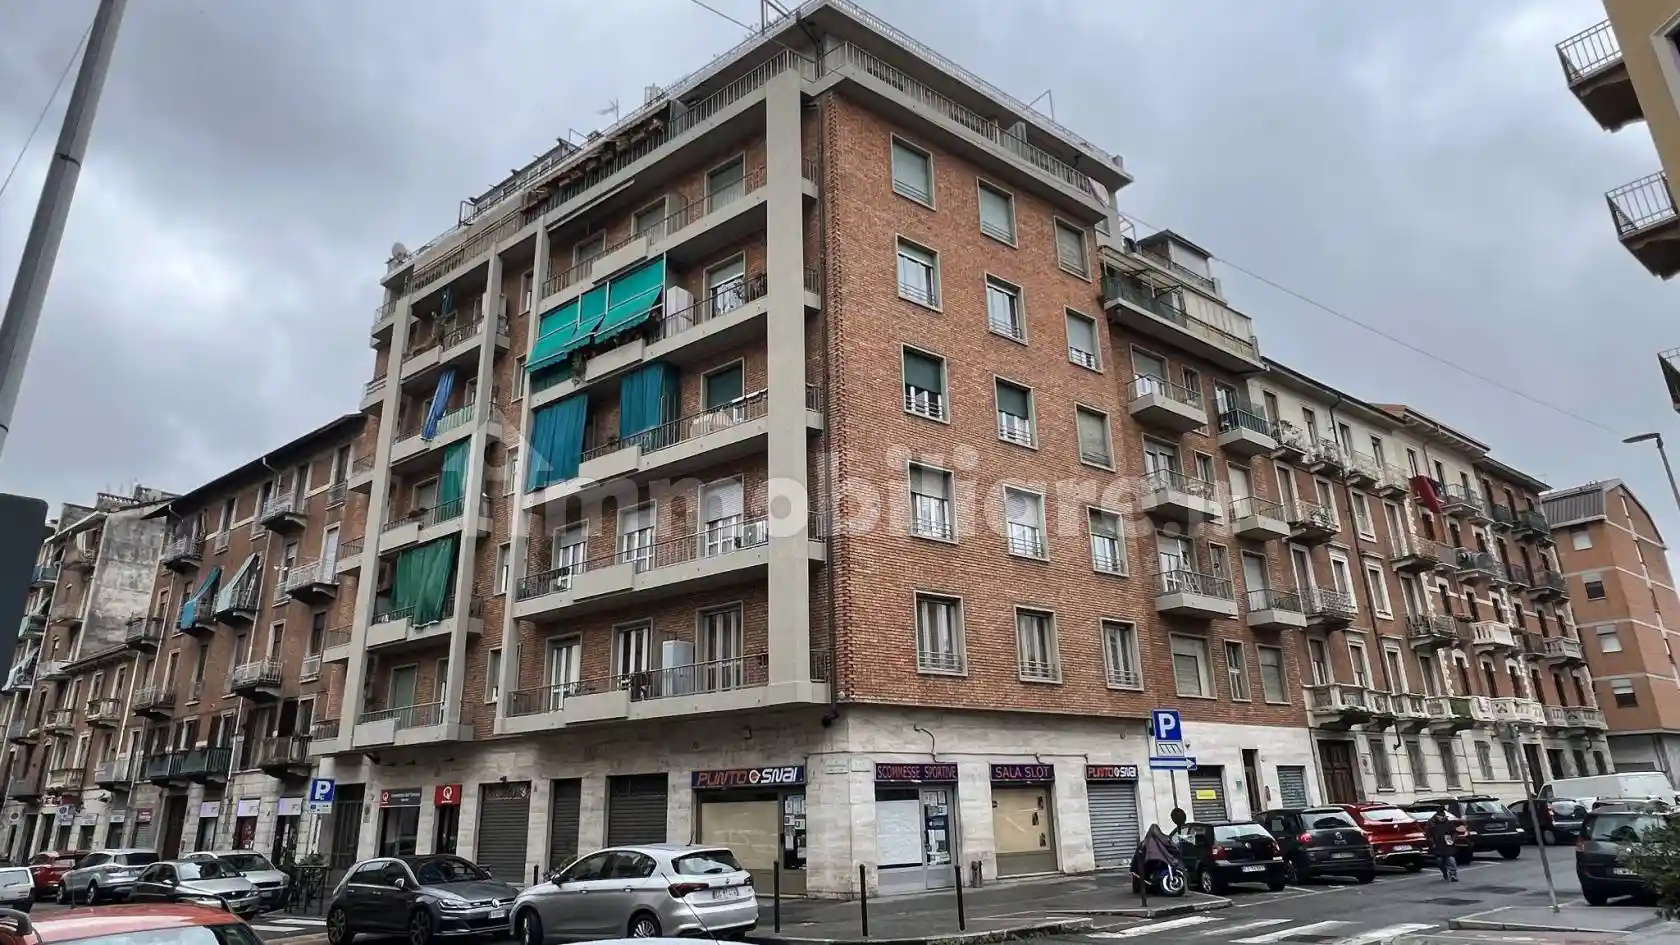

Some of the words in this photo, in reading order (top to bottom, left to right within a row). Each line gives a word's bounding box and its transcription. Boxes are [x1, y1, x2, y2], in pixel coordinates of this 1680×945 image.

[1158, 713, 1176, 738] P
[698, 770, 747, 786] PUNTO
[877, 765, 921, 778] SCOMMESSE
[924, 765, 957, 778] SPORTIVE
[995, 766, 1022, 778] SALA
[1024, 766, 1049, 778] SLOT
[1088, 767, 1114, 777] PUNTO
[315, 780, 331, 800] P
